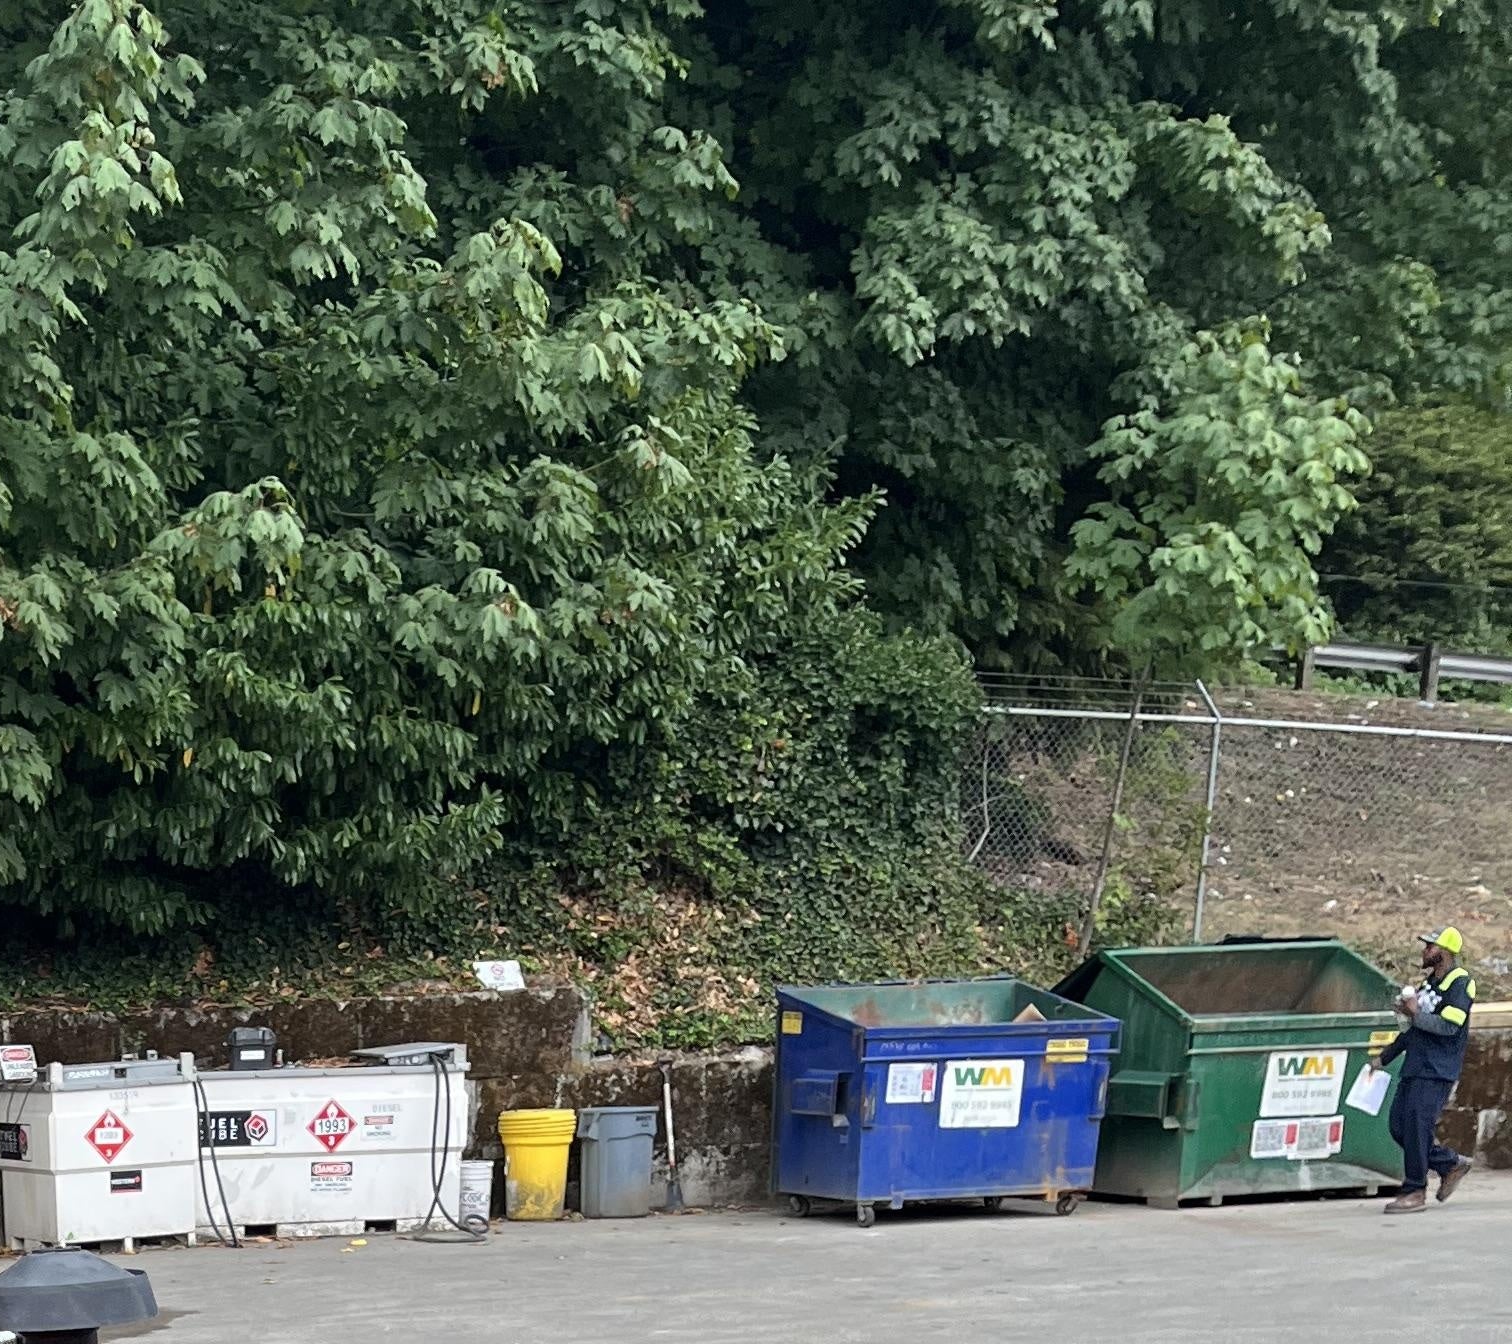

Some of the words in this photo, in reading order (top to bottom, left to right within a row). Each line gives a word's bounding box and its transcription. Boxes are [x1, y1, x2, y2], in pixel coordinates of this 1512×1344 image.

[1278, 1056, 1335, 1076] WM
[955, 1067, 1012, 1086] WM
[319, 1119, 346, 1133] 1993
[328, 1135, 335, 1146] 3
[105, 1149, 112, 1157] 3
